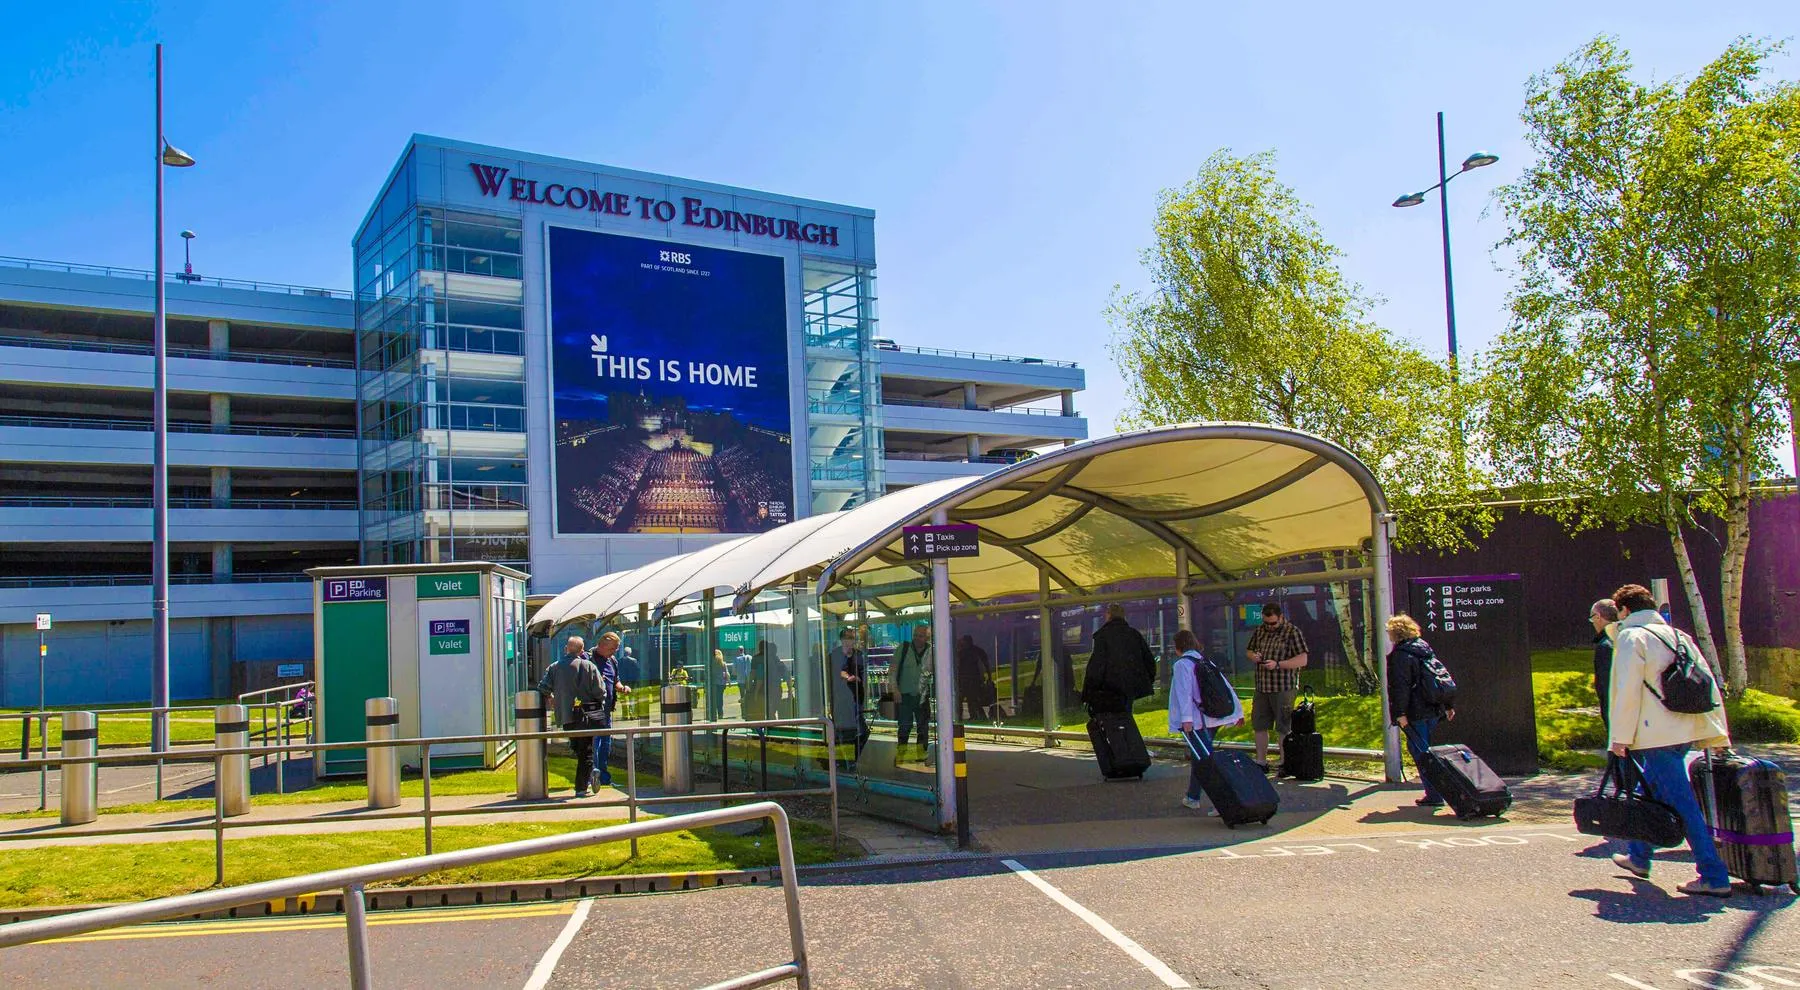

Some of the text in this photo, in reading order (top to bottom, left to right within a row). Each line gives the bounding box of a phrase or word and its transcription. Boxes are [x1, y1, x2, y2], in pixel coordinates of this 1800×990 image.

[470, 163, 840, 246] WELCOME TO EDINBURGH
[671, 252, 691, 265] RBS
[591, 354, 758, 387] THIS IS HOME
[936, 533, 955, 541] Taxis
[435, 580, 462, 591] Valet
[1470, 585, 1491, 594] parks
[350, 588, 381, 598] Parking
[1457, 622, 1477, 630] Valet
[438, 640, 463, 649] Valet
[1217, 843, 1380, 860] LEFT
